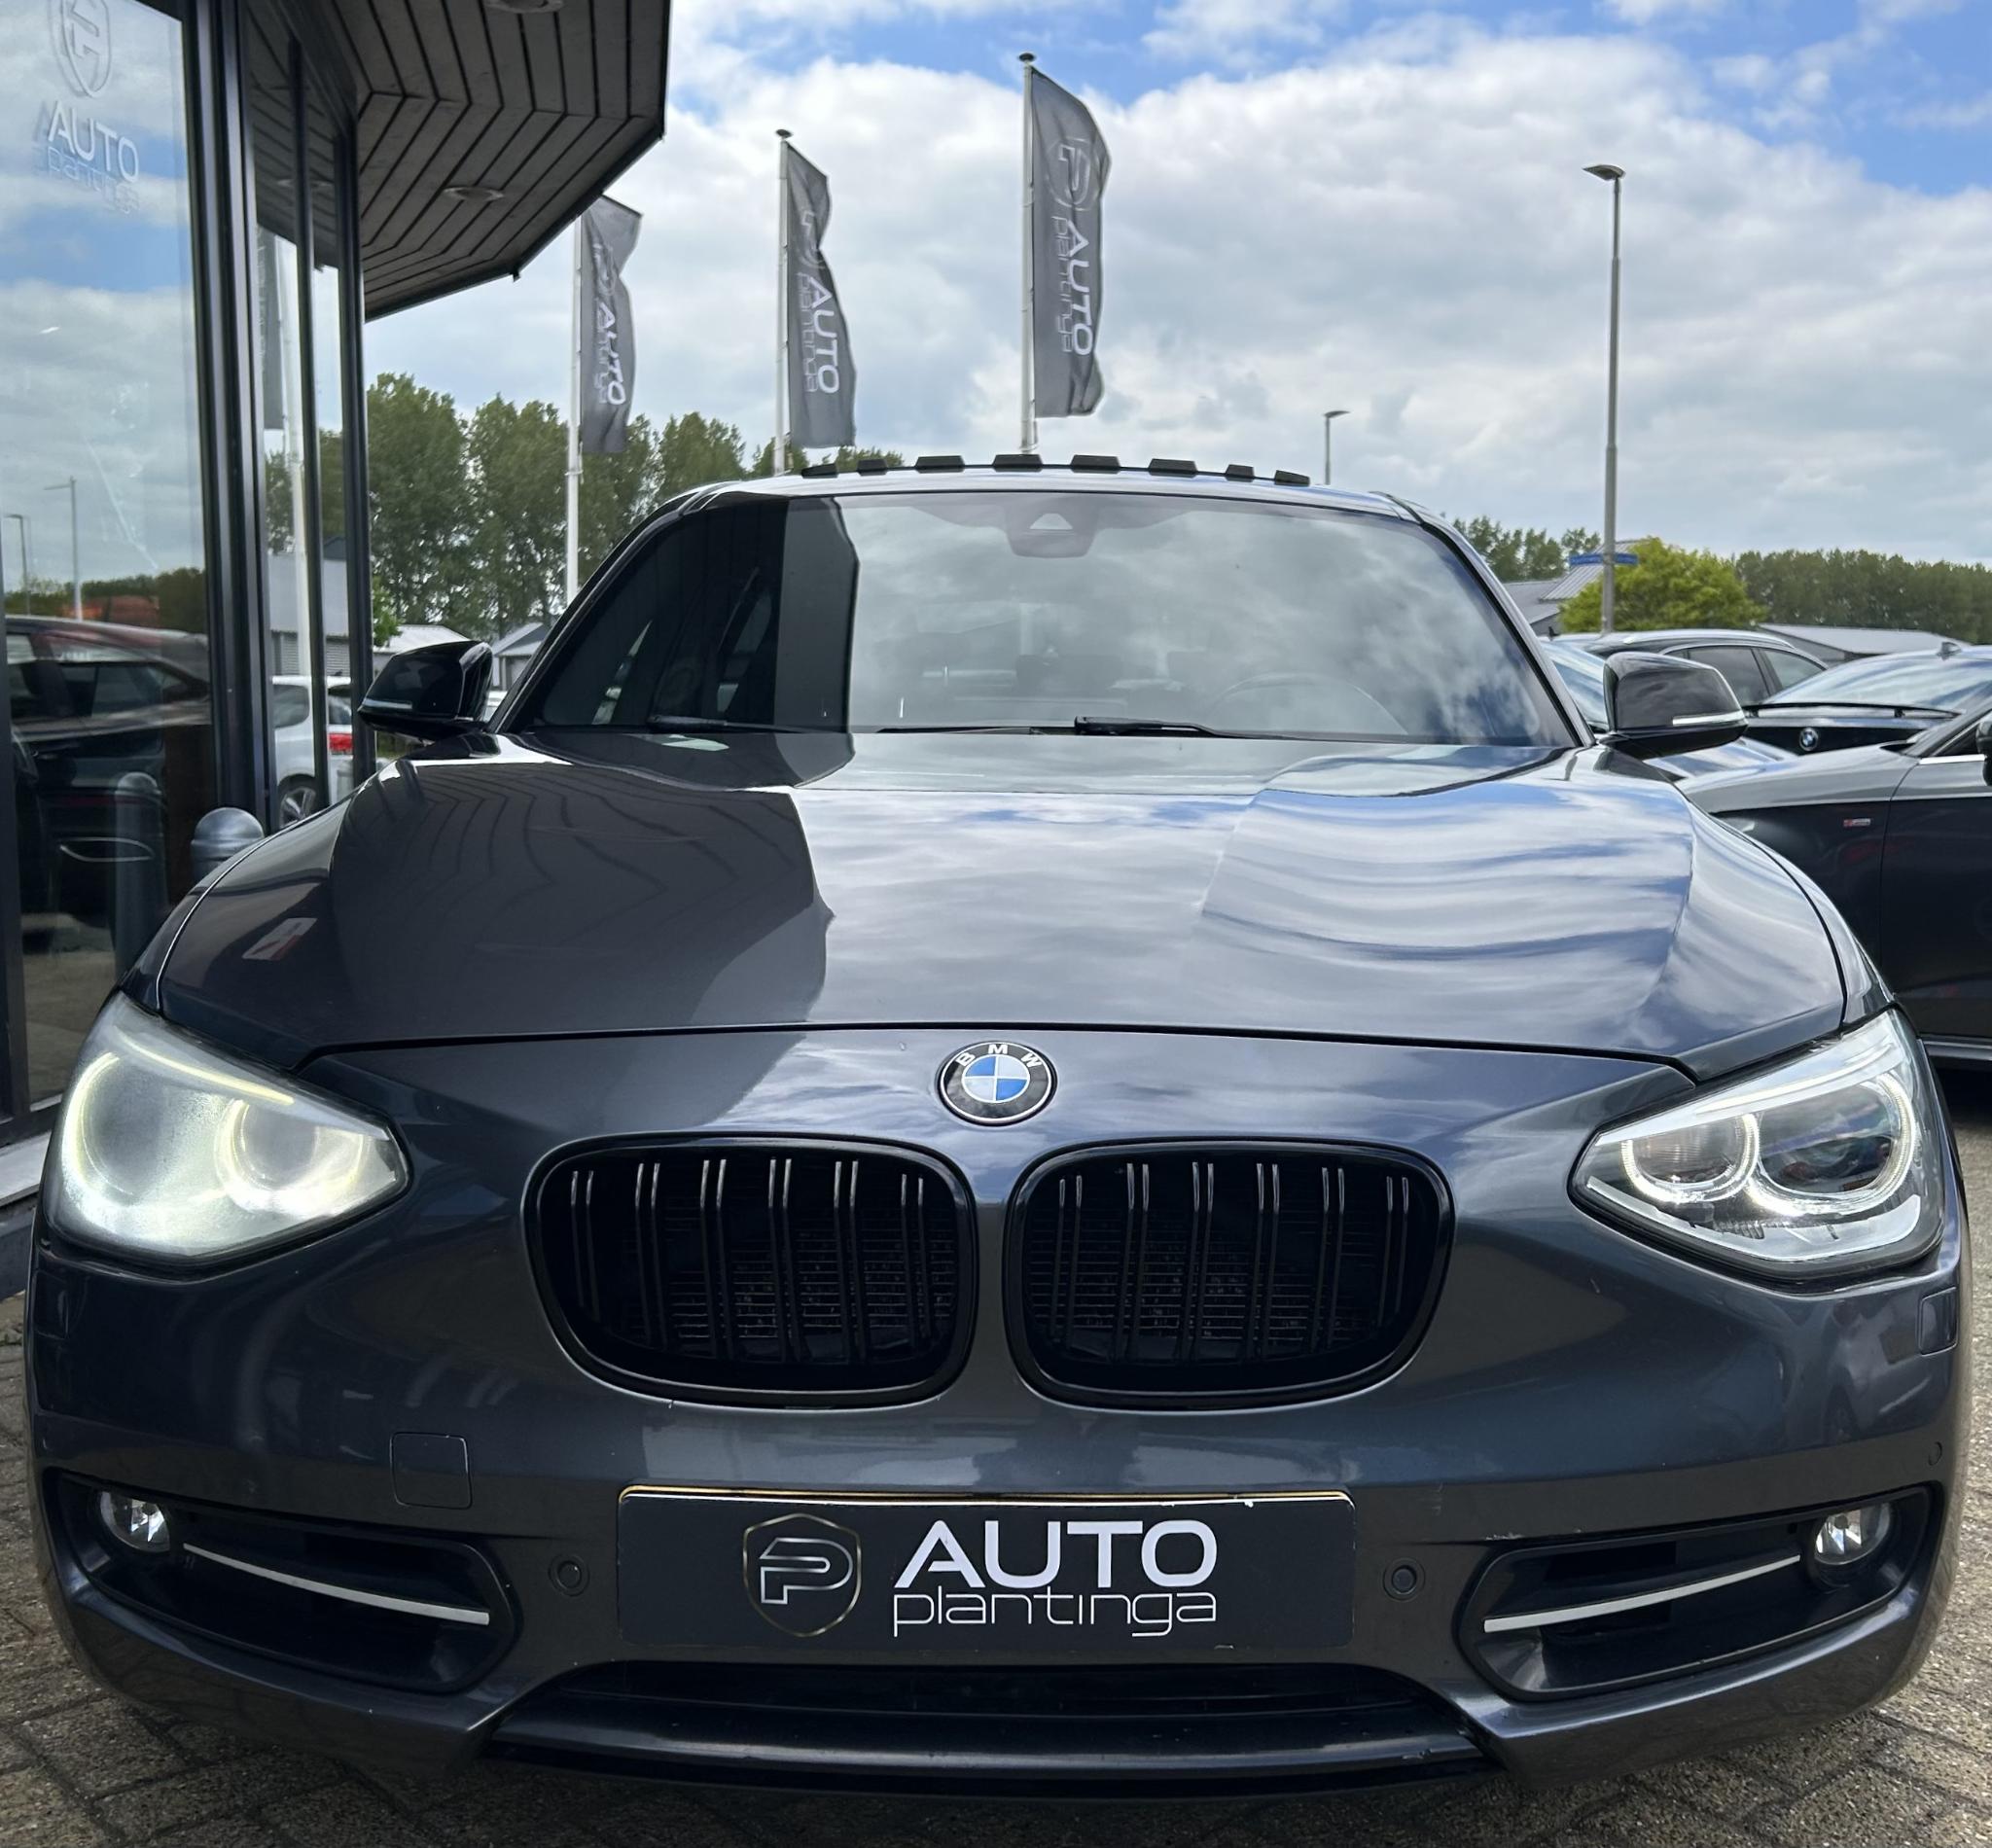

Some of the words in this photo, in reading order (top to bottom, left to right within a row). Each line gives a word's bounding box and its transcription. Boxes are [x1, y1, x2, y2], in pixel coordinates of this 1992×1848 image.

[48, 100, 139, 183] AUTO
[1050, 215, 1074, 353] plantinga
[1066, 220, 1093, 355] AUTO
[808, 276, 840, 394] AUTO
[955, 1044, 1042, 1068] BMW
[895, 1520, 1217, 1588] AUTO
[894, 1585, 1217, 1638] plantinga
